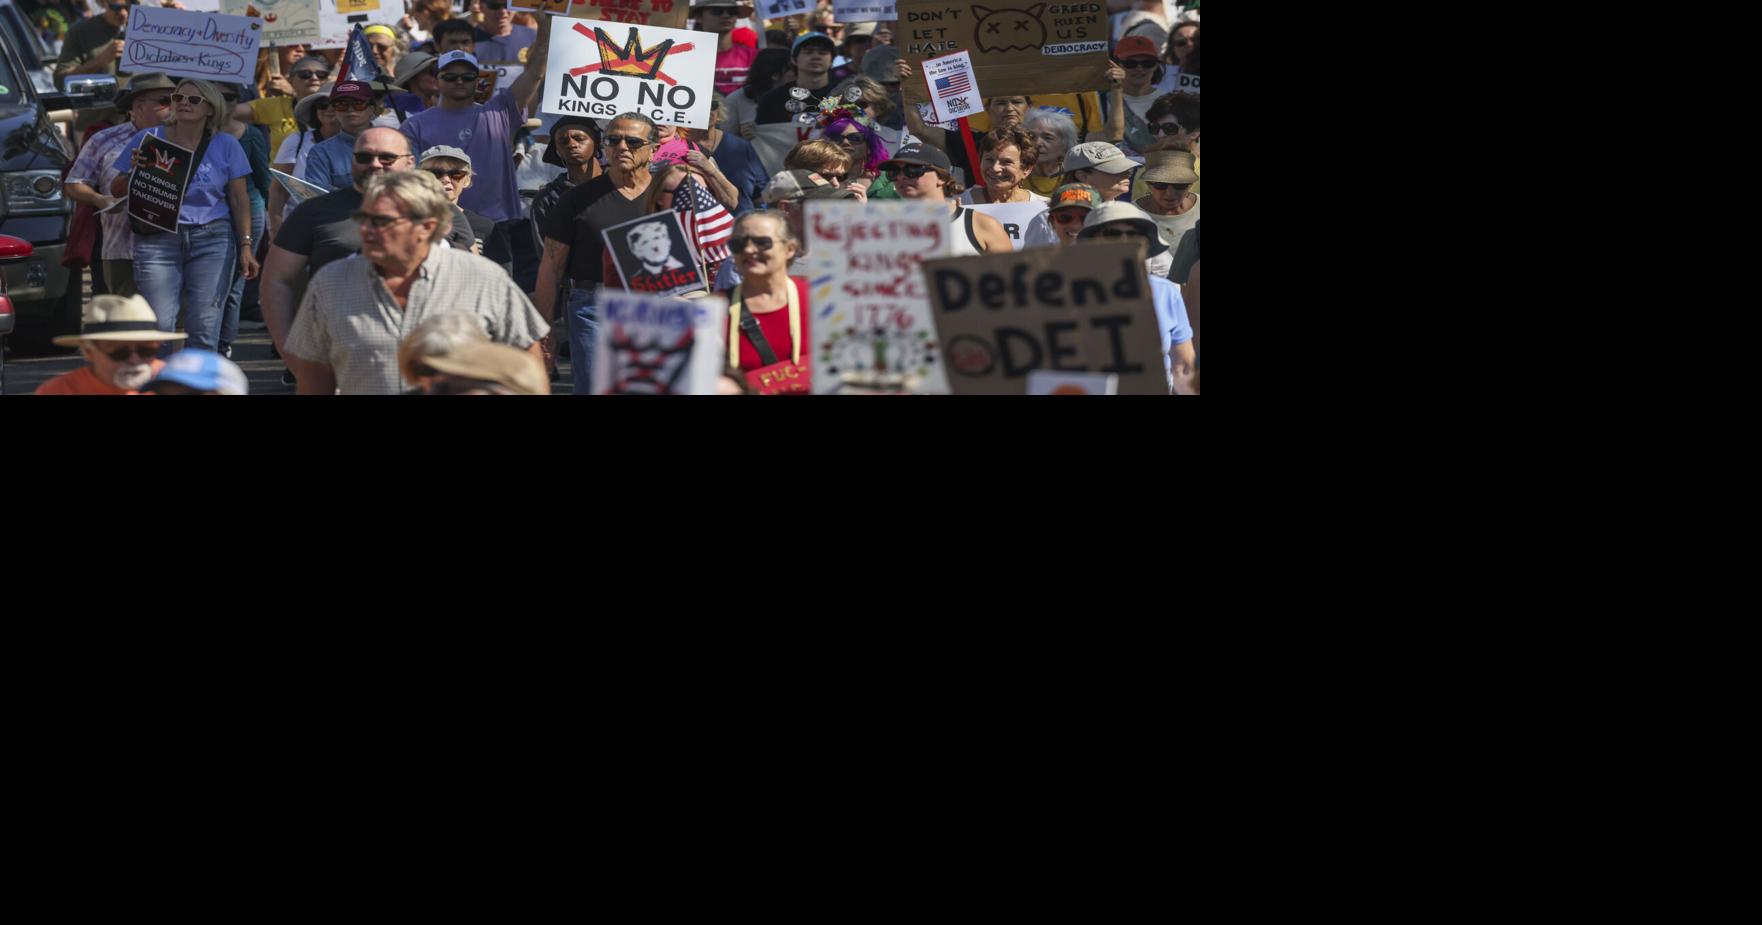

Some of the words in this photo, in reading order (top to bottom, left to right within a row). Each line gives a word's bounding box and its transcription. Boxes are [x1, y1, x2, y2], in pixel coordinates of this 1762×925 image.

[907, 8, 962, 22] DON'T
[1049, 3, 1101, 14] GREED
[1055, 15, 1097, 26] RUIN
[913, 28, 948, 40] LET
[1057, 27, 1087, 39] US
[907, 40, 958, 54] HATE
[561, 73, 619, 101] NO
[637, 82, 696, 110] NO
[558, 99, 617, 116] KINGS
[134, 179, 147, 189] NO
[148, 184, 178, 201] TRUMP
[139, 170, 151, 181] NO
[151, 175, 178, 192] KINGS.
[132, 188, 177, 212] TAKEOVER.
[934, 257, 1142, 312] Defend
[855, 303, 915, 330] 1776
[994, 314, 1146, 378] DEI
